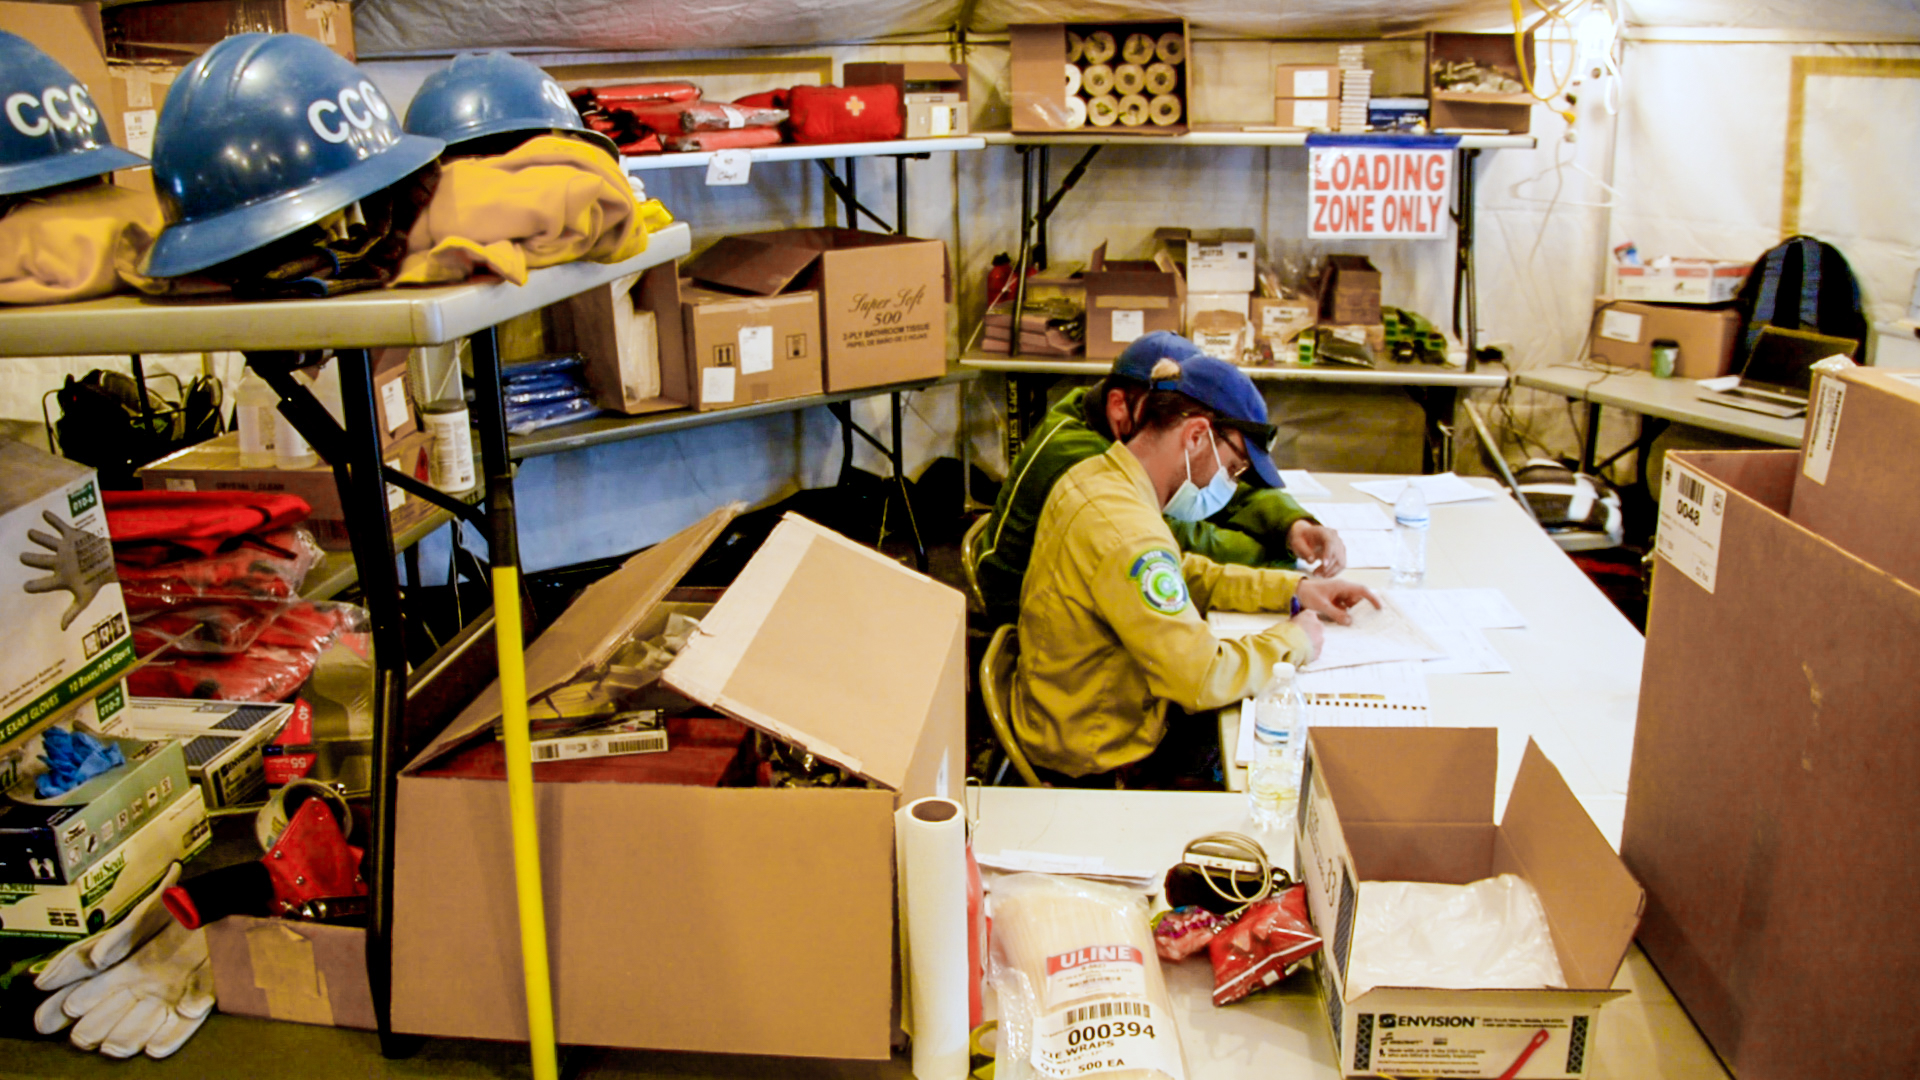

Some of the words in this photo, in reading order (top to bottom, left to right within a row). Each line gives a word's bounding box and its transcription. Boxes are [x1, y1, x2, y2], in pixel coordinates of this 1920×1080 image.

[5, 84, 99, 137] CCC
[307, 80, 389, 144] CCC
[1313, 154, 1445, 191] LOADING
[1313, 195, 1375, 232] ZONE
[1382, 195, 1443, 232] ONLY
[848, 292, 891, 319] Super
[893, 285, 926, 314] Soft
[864, 326, 905, 338] BATHROOM
[905, 322, 930, 333] TISSUE
[872, 310, 902, 327] 500
[1677, 499, 1700, 527] 0048
[6, 713, 29, 736] EXAM
[29, 694, 60, 719] GLOVES
[69, 680, 79, 694] 10
[83, 849, 126, 890] UniSeal
[1060, 946, 1132, 968] ULINE
[1068, 1022, 1155, 1046] 000394
[1398, 1015, 1475, 1028] ENVISION
[1065, 1040, 1115, 1056] WRAPS
[1040, 1062, 1071, 1076] QTY:
[1078, 1060, 1103, 1074] 500
[1107, 1058, 1125, 1067] EA
